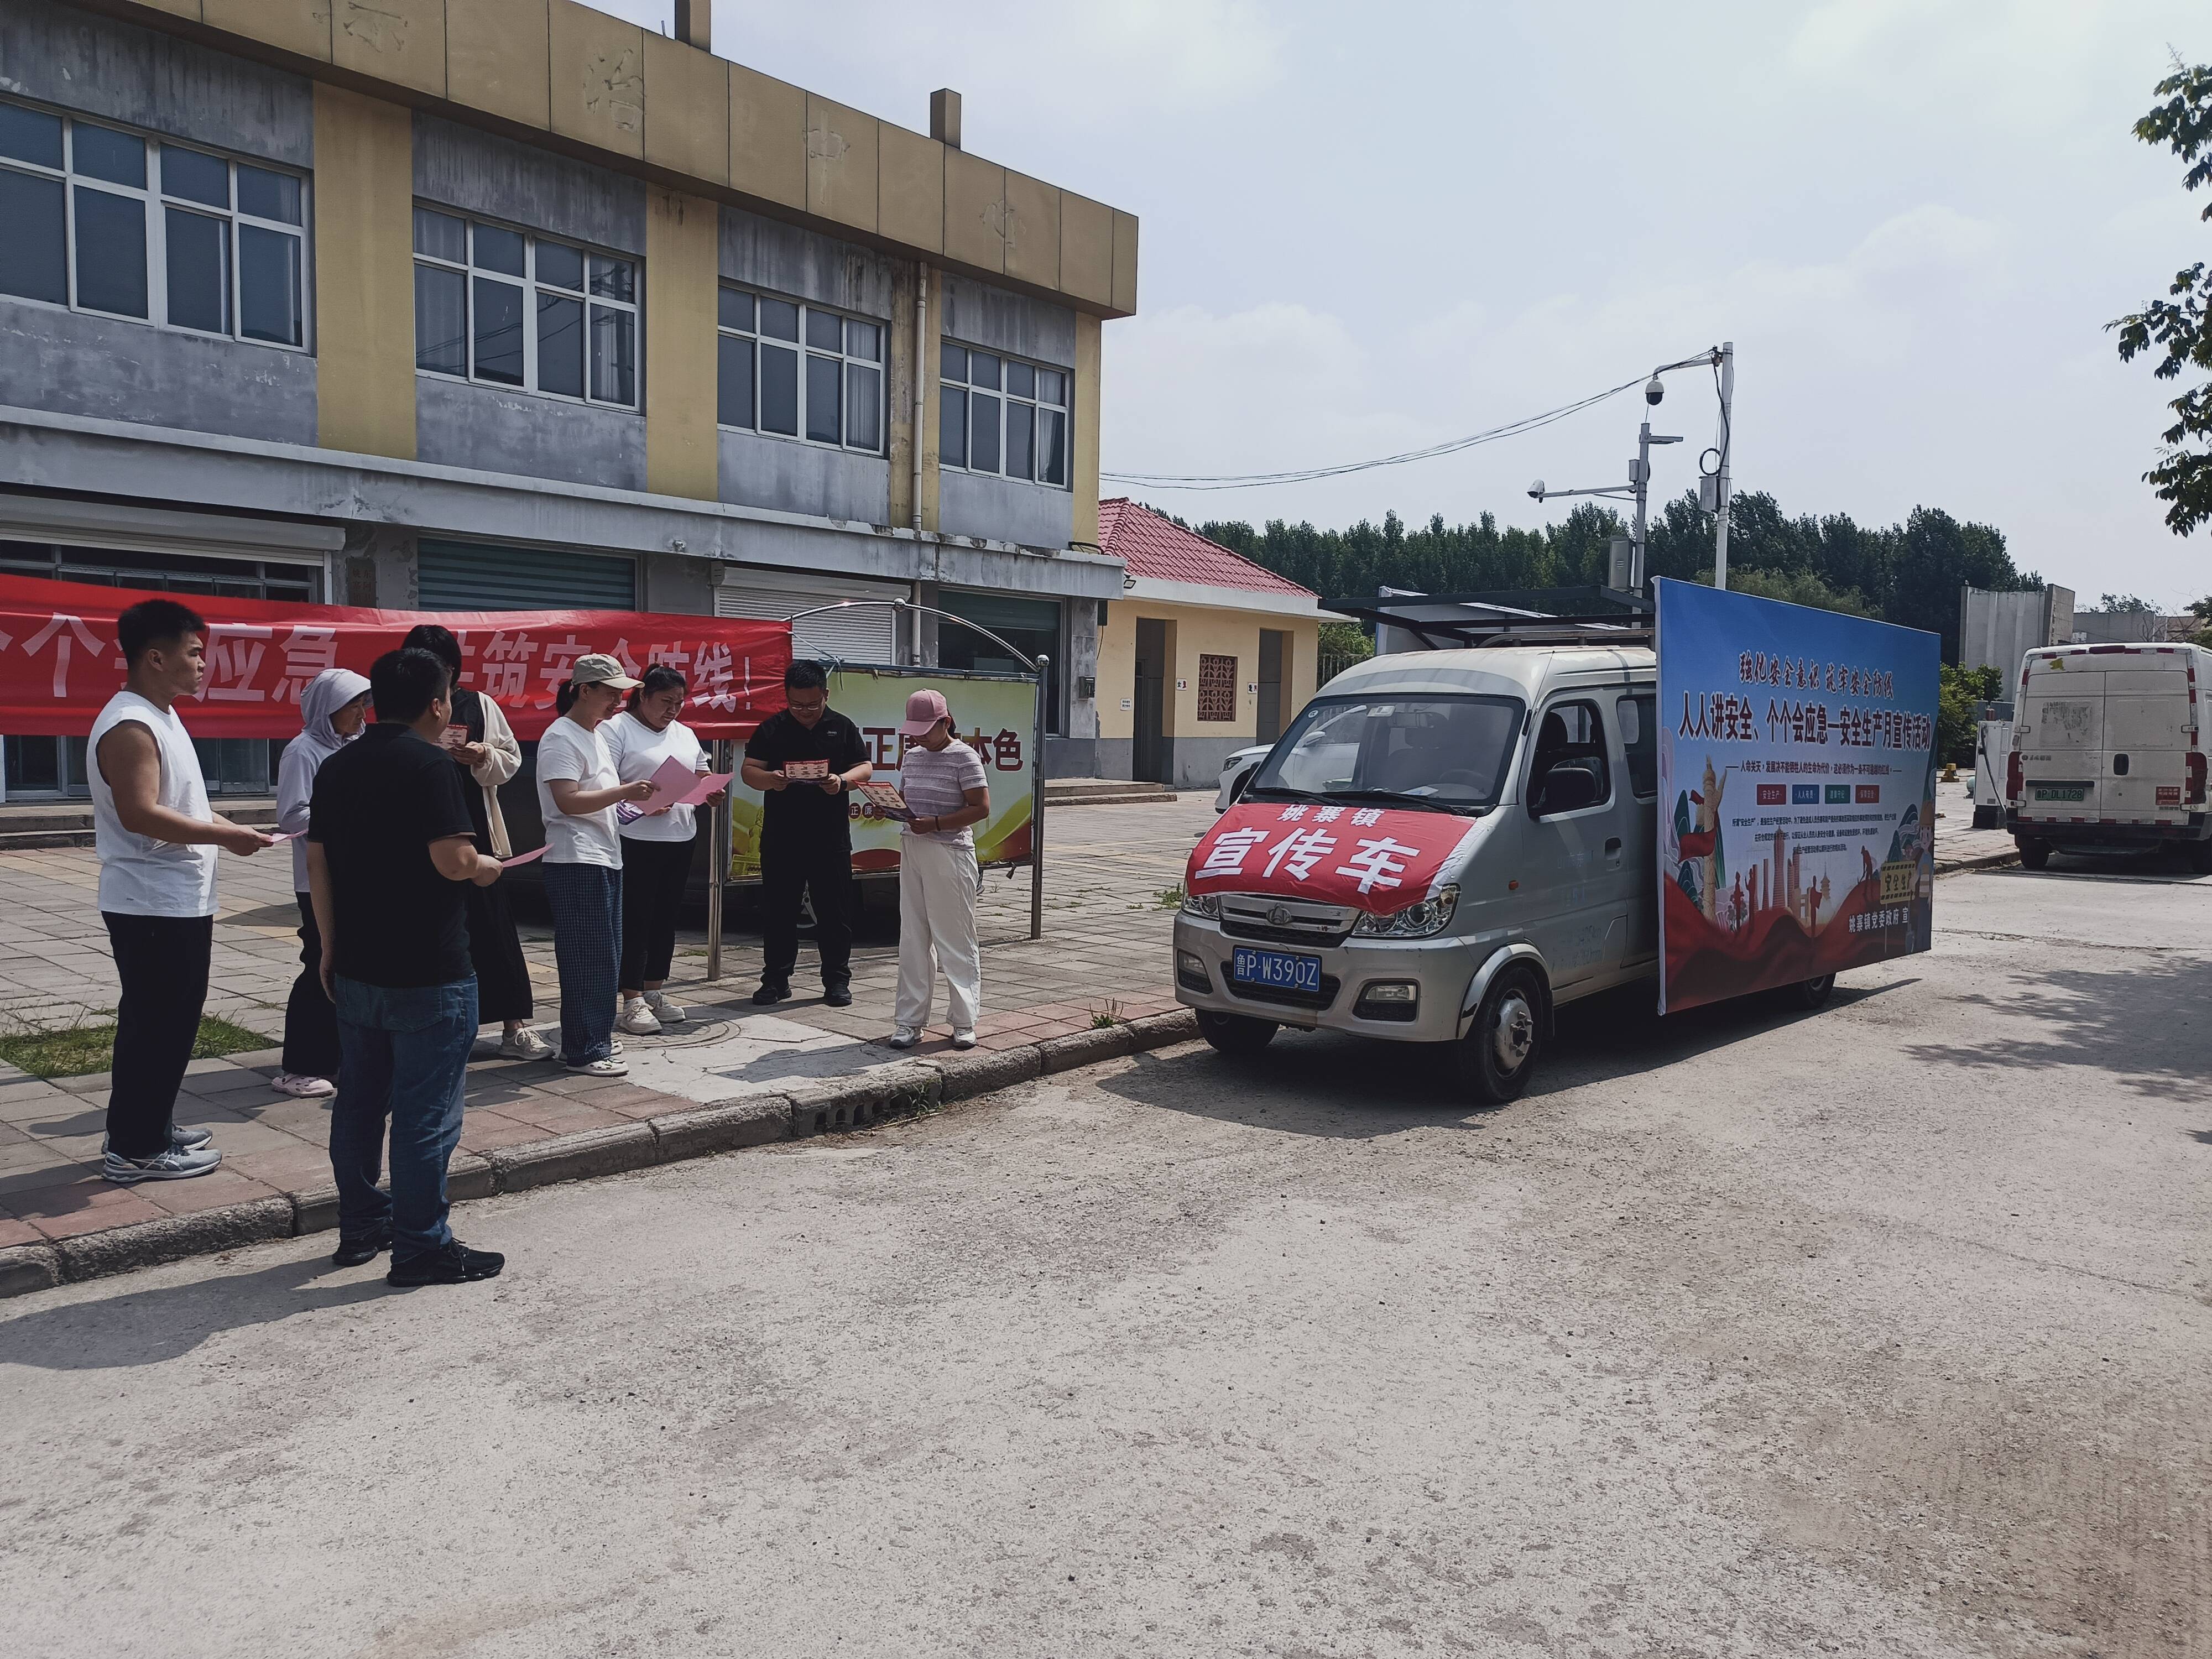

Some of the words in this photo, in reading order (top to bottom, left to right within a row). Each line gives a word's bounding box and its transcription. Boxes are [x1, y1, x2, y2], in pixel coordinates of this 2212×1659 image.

[0, 612, 338, 704] 个应急
[456, 630, 751, 713] 筑安线！
[1276, 805, 1385, 828] 姚寨镇
[1194, 827, 1420, 894] 宣传车
[1849, 907, 1899, 933] 姚寨镇党委政府
